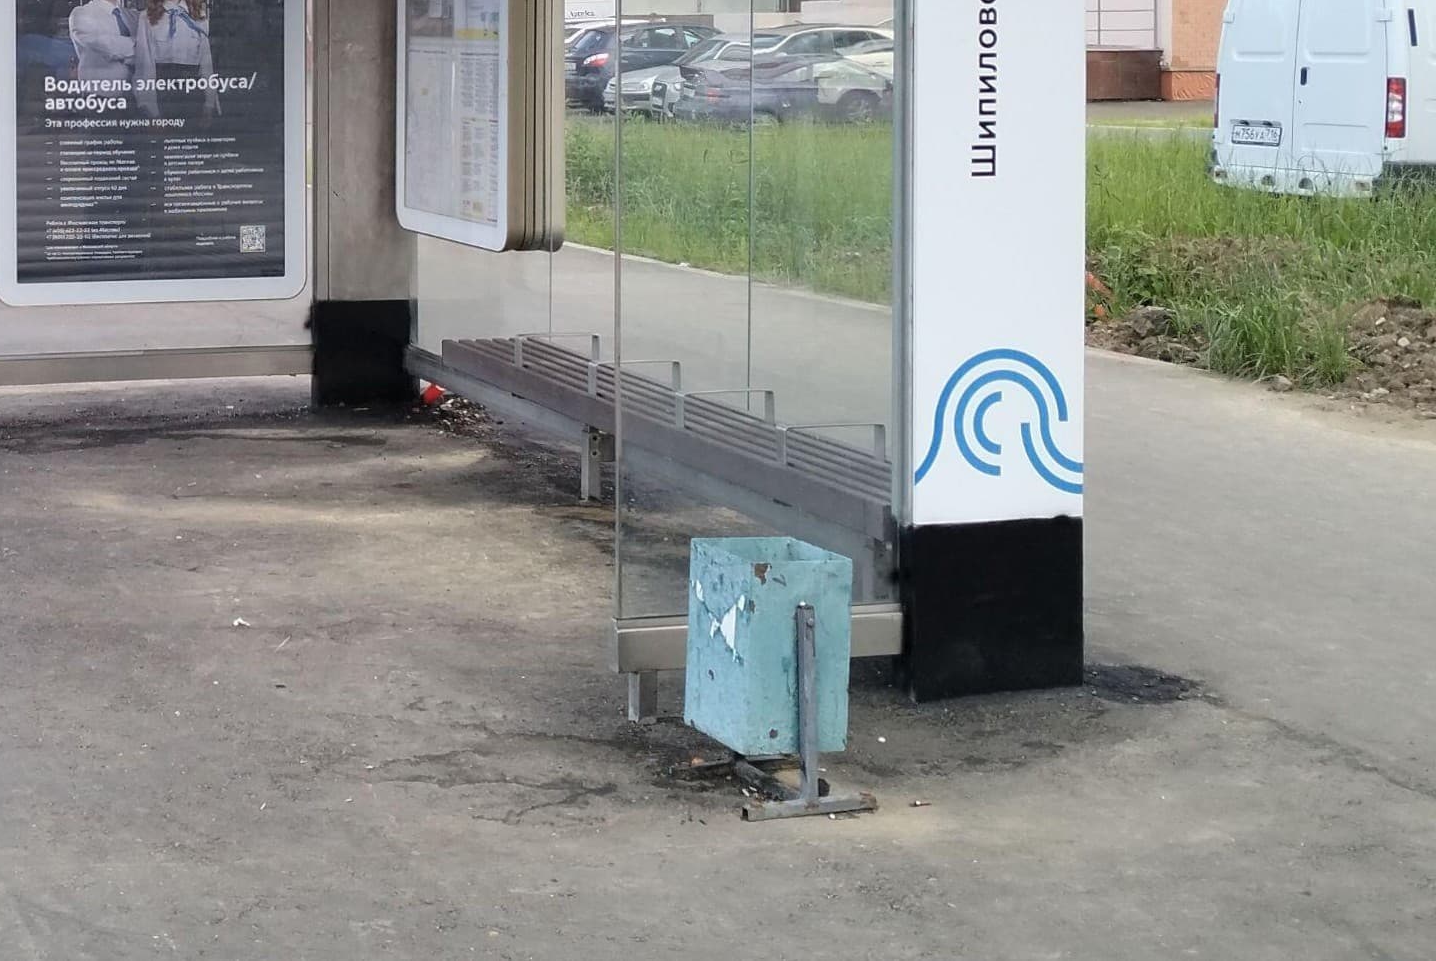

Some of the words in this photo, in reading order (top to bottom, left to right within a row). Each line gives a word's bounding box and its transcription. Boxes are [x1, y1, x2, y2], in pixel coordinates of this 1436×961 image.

[44, 76, 132, 94] Водитель
[136, 72, 256, 94] электробуса/
[45, 94, 127, 113] автобуса
[45, 118, 62, 129] Эта
[64, 118, 117, 129] профессия
[119, 118, 150, 128] нужна
[152, 116, 186, 128] городу
